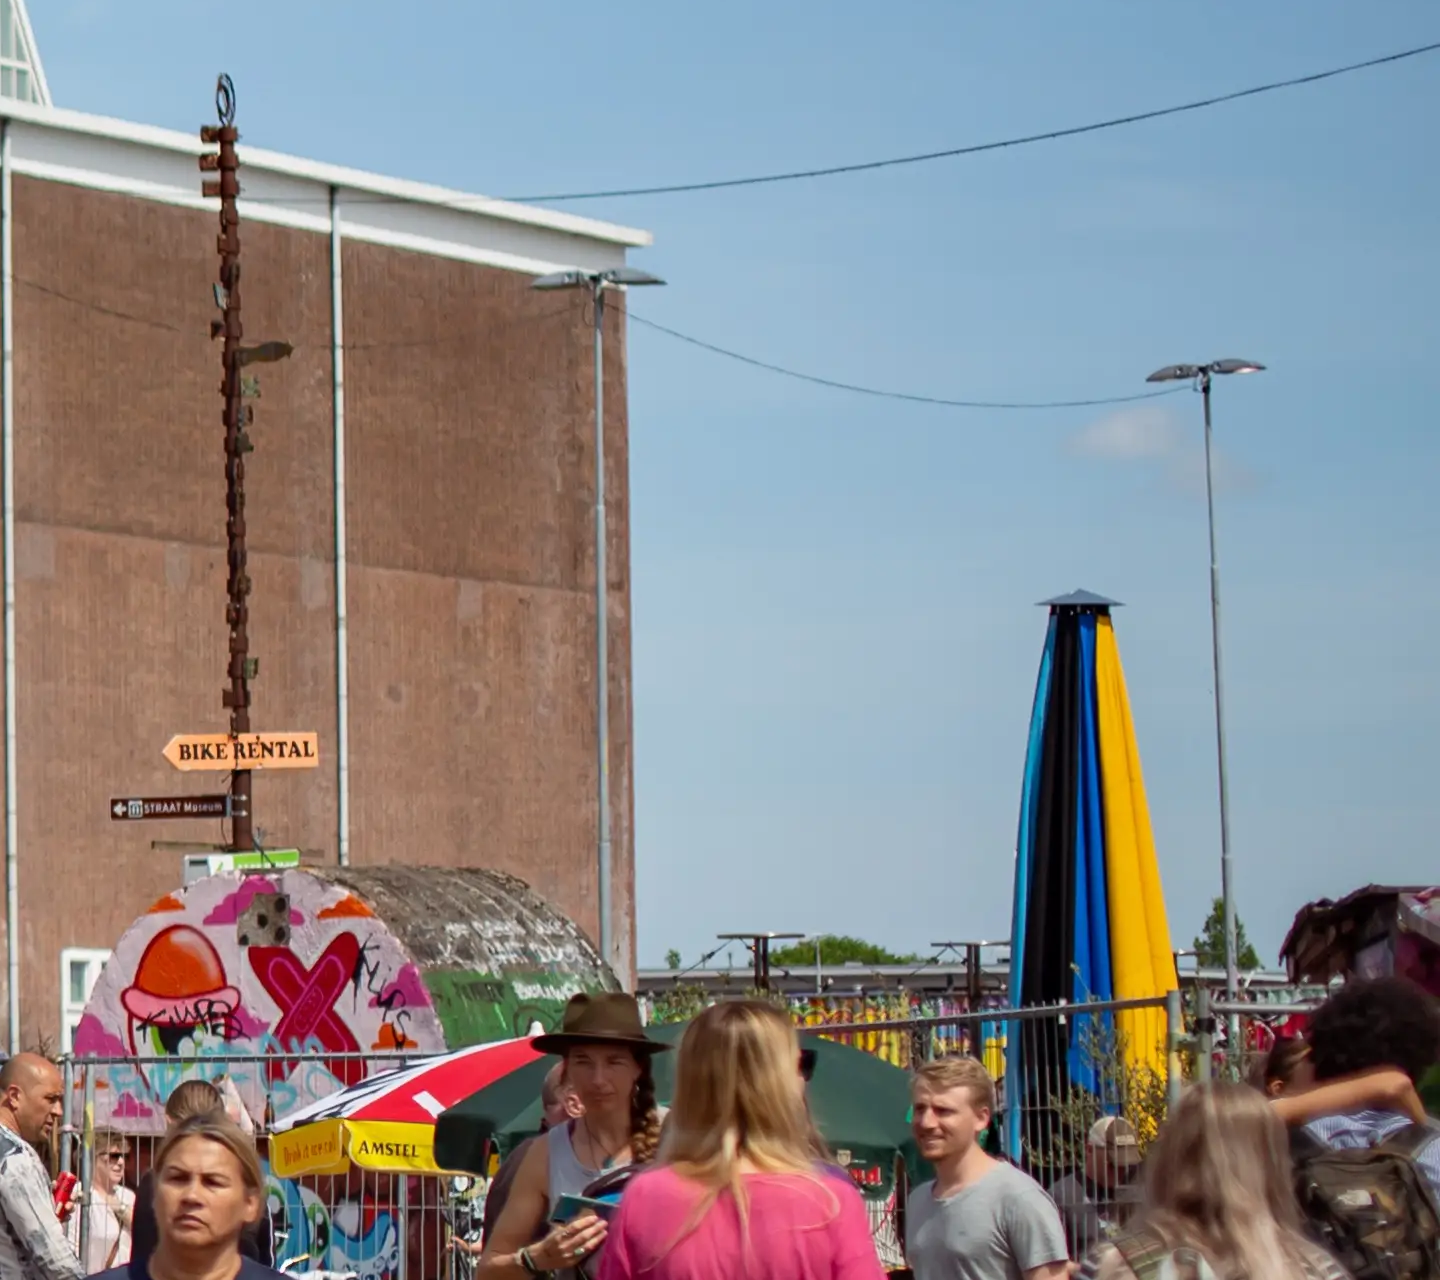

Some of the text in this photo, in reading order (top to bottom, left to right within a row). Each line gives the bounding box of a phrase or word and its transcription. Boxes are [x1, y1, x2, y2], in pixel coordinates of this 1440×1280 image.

[179, 739, 315, 761] BIKE RENTAL
[143, 802, 223, 814] STRAAT Museum
[358, 1140, 419, 1158] AMSTEL
